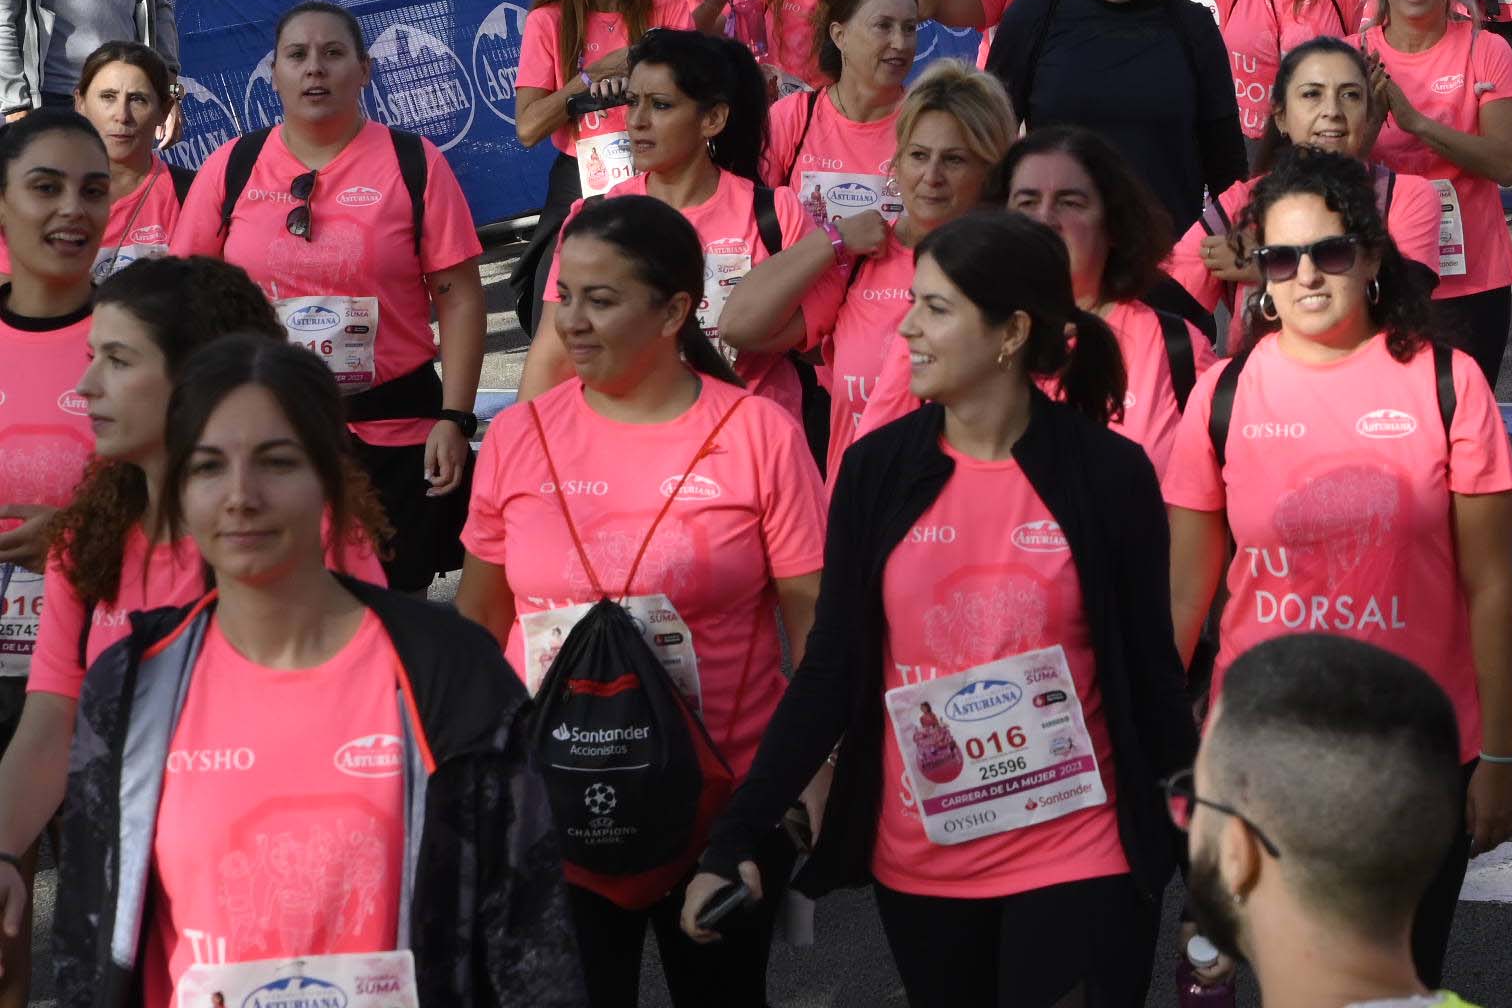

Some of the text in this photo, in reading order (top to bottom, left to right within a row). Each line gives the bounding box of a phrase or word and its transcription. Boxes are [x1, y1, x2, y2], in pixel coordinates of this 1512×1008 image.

[1232, 51, 1257, 74] TU
[338, 193, 381, 204] ASTURIANA
[829, 190, 876, 205] ASTURIANA
[291, 315, 336, 327] ASTURIANA
[1242, 422, 1306, 440] OYSHO
[912, 525, 957, 543] SHO
[1245, 546, 1290, 578] TU
[649, 614, 678, 624] SUMA
[1255, 590, 1406, 630] DORSAL
[2, 643, 30, 652] DE LA
[1026, 671, 1059, 685] SUMA
[952, 689, 1018, 718] ASTURIANA
[571, 725, 649, 743] Santander
[965, 725, 1028, 761] 016
[570, 744, 628, 757] Accionistas
[979, 755, 1027, 781] 25596
[941, 791, 988, 810] CARRERA
[989, 784, 1005, 798] DE
[1006, 780, 1020, 795] LA
[1021, 769, 1057, 788] MUJER
[1038, 781, 1093, 809] Santander
[944, 808, 997, 833] OYSHO
[357, 979, 401, 994] SUMA
